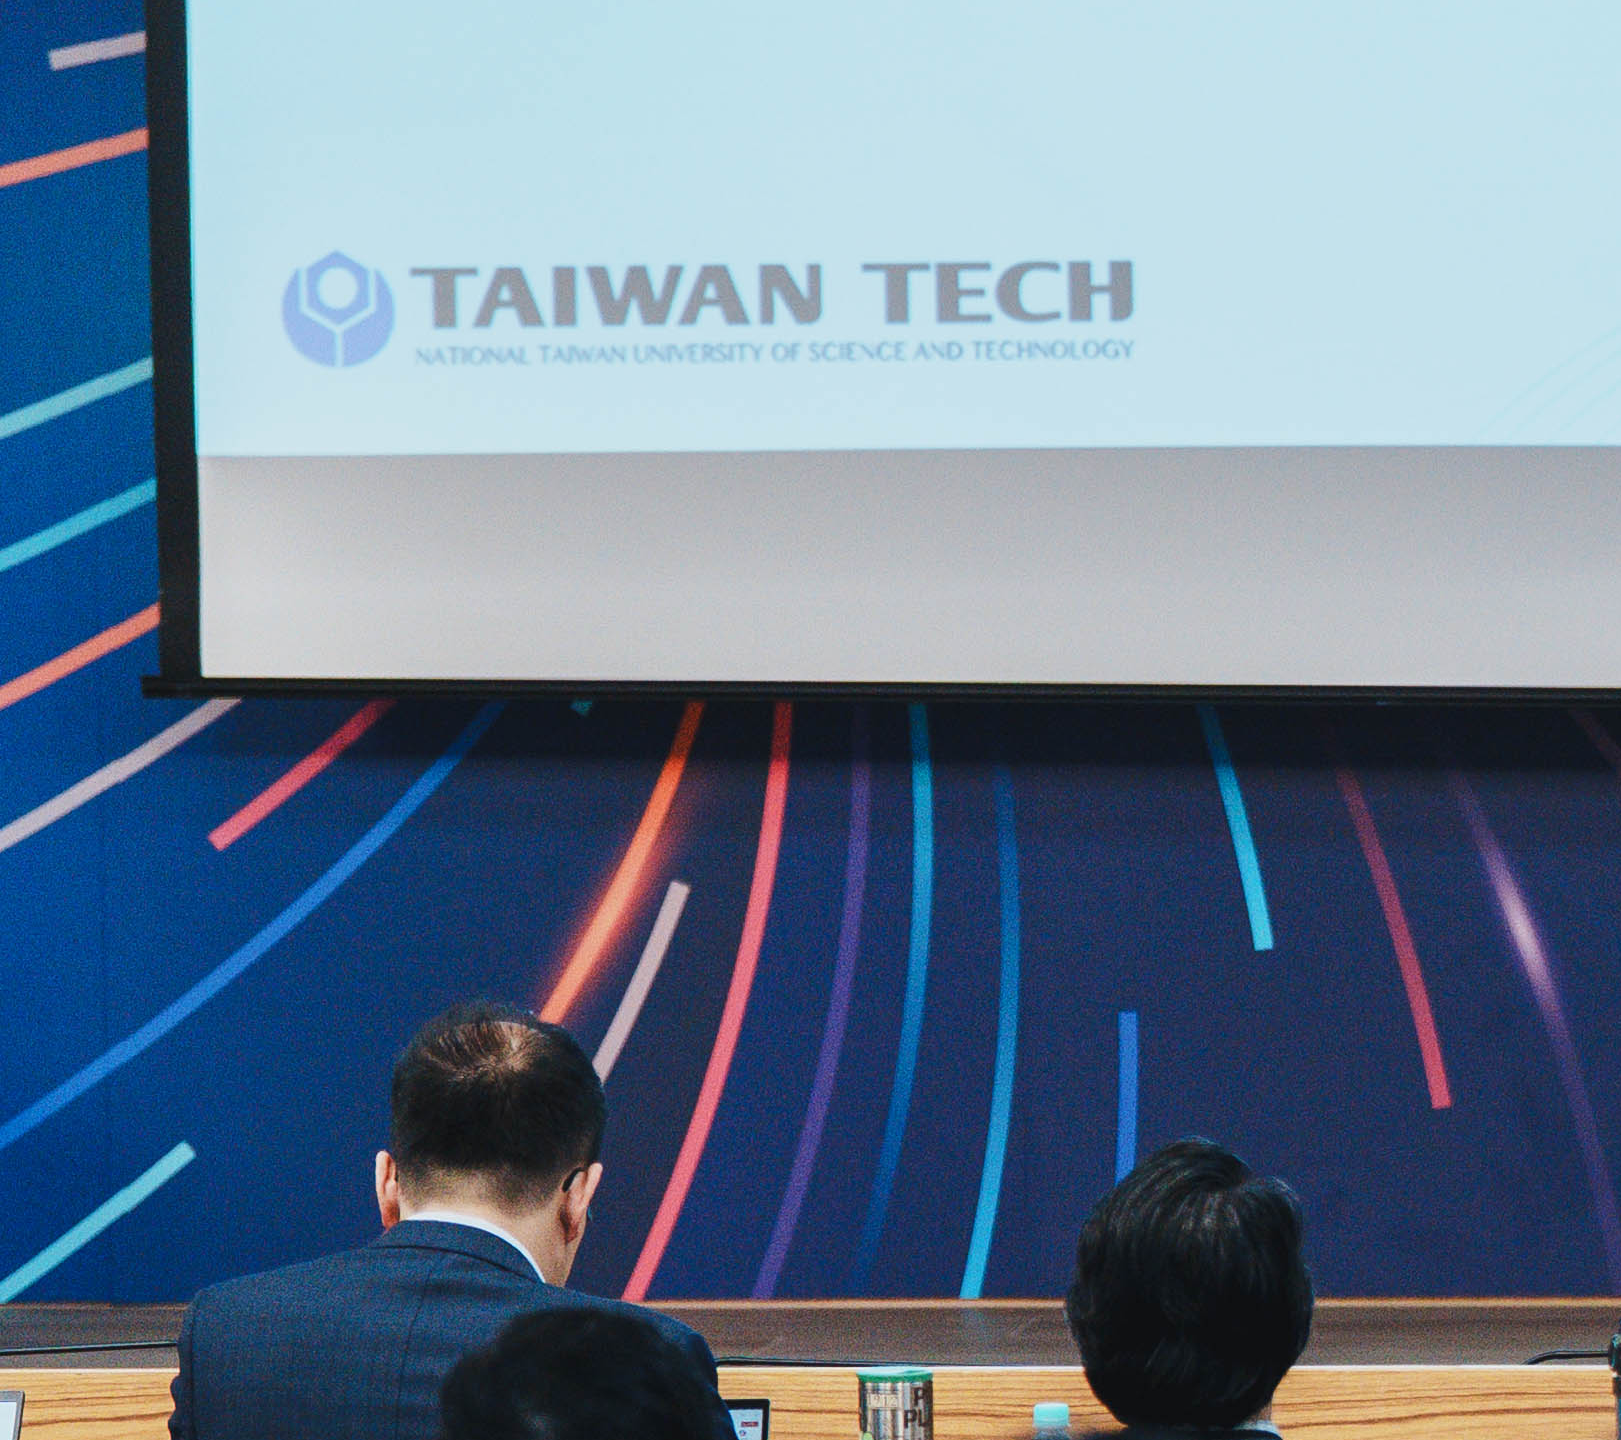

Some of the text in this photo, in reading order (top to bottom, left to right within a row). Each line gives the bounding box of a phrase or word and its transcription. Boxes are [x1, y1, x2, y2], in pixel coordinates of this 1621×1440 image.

[410, 260, 1134, 328] TAIWAN TECH
[416, 339, 1134, 365] NATIONAL TAIWAN UNIVERSITY OF SCIENCE AND TECHNOLOGY
